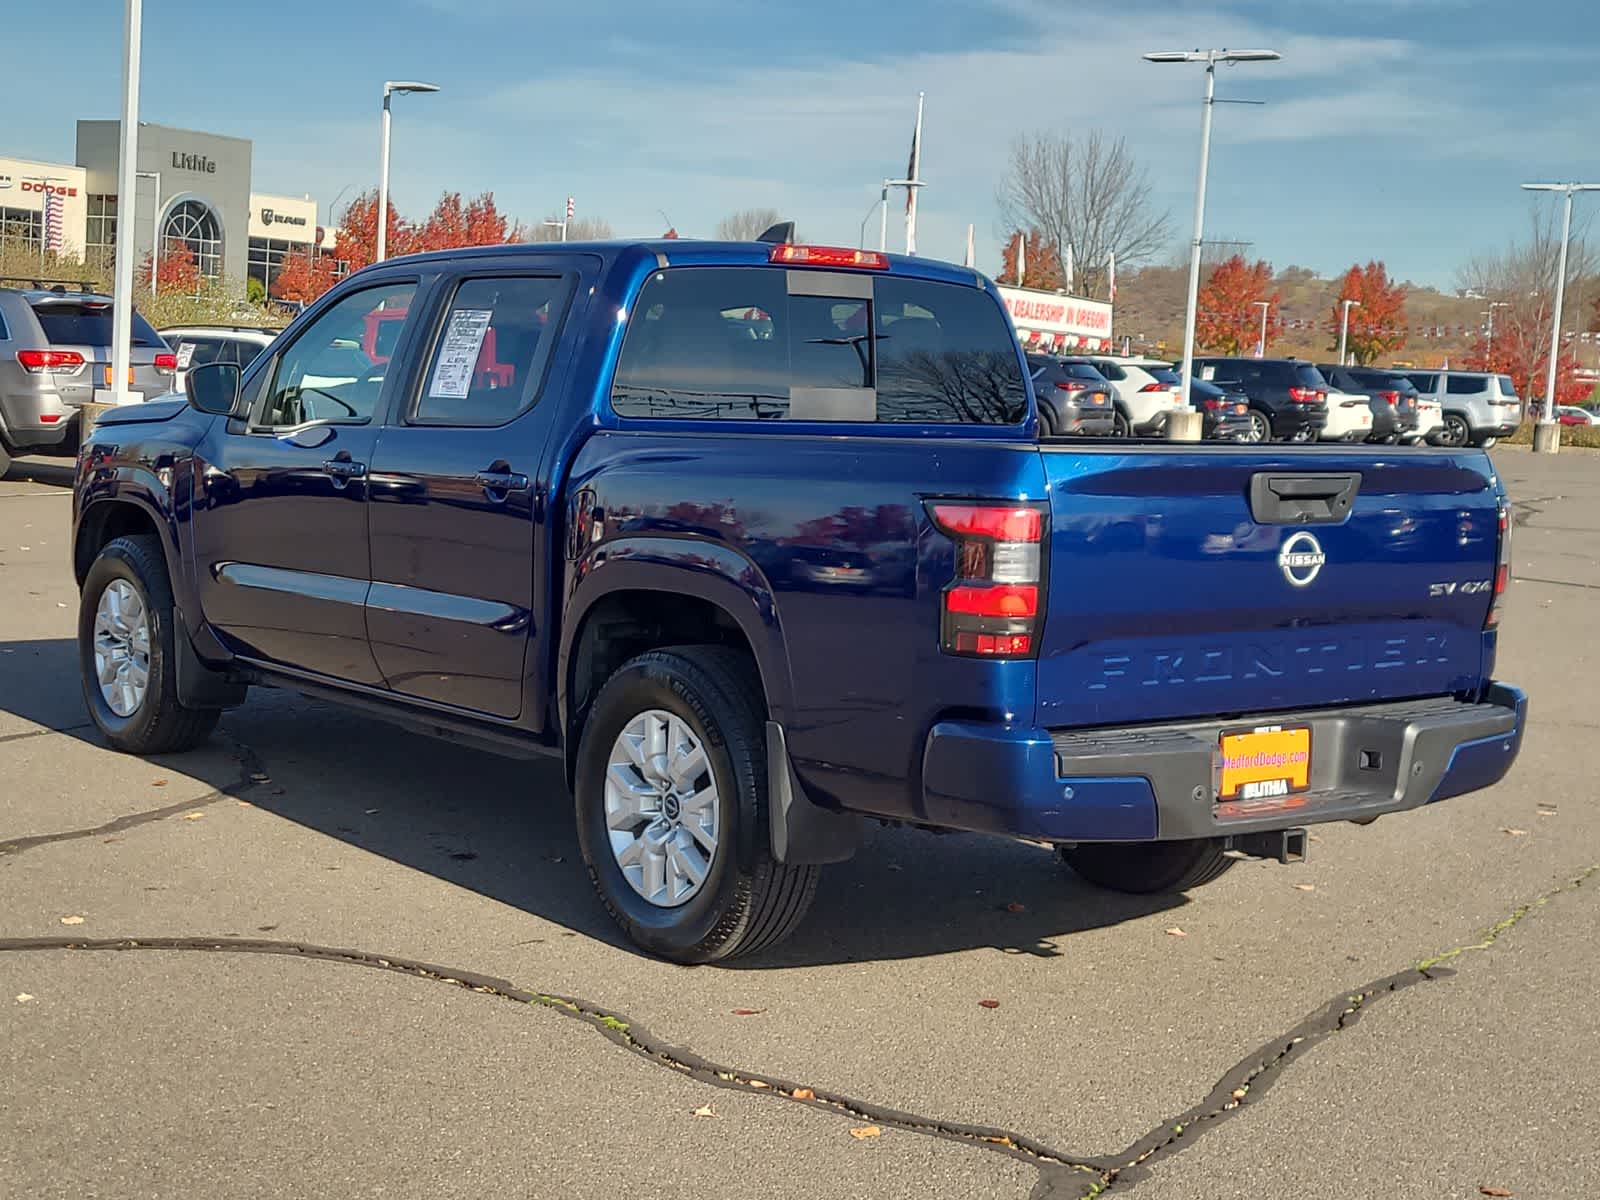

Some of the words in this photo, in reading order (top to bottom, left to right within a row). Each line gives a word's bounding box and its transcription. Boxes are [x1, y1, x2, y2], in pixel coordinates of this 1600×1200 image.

[172, 151, 216, 174] Lithia
[21, 181, 77, 197] DODGE
[1014, 299, 1065, 321] DEALERSHIP
[1066, 306, 1075, 324] IN
[1280, 553, 1325, 567] NISSAN
[1429, 582, 1457, 597] SV
[1088, 634, 1450, 690] FRONTIER
[1223, 751, 1307, 769] MedfordDodge.com
